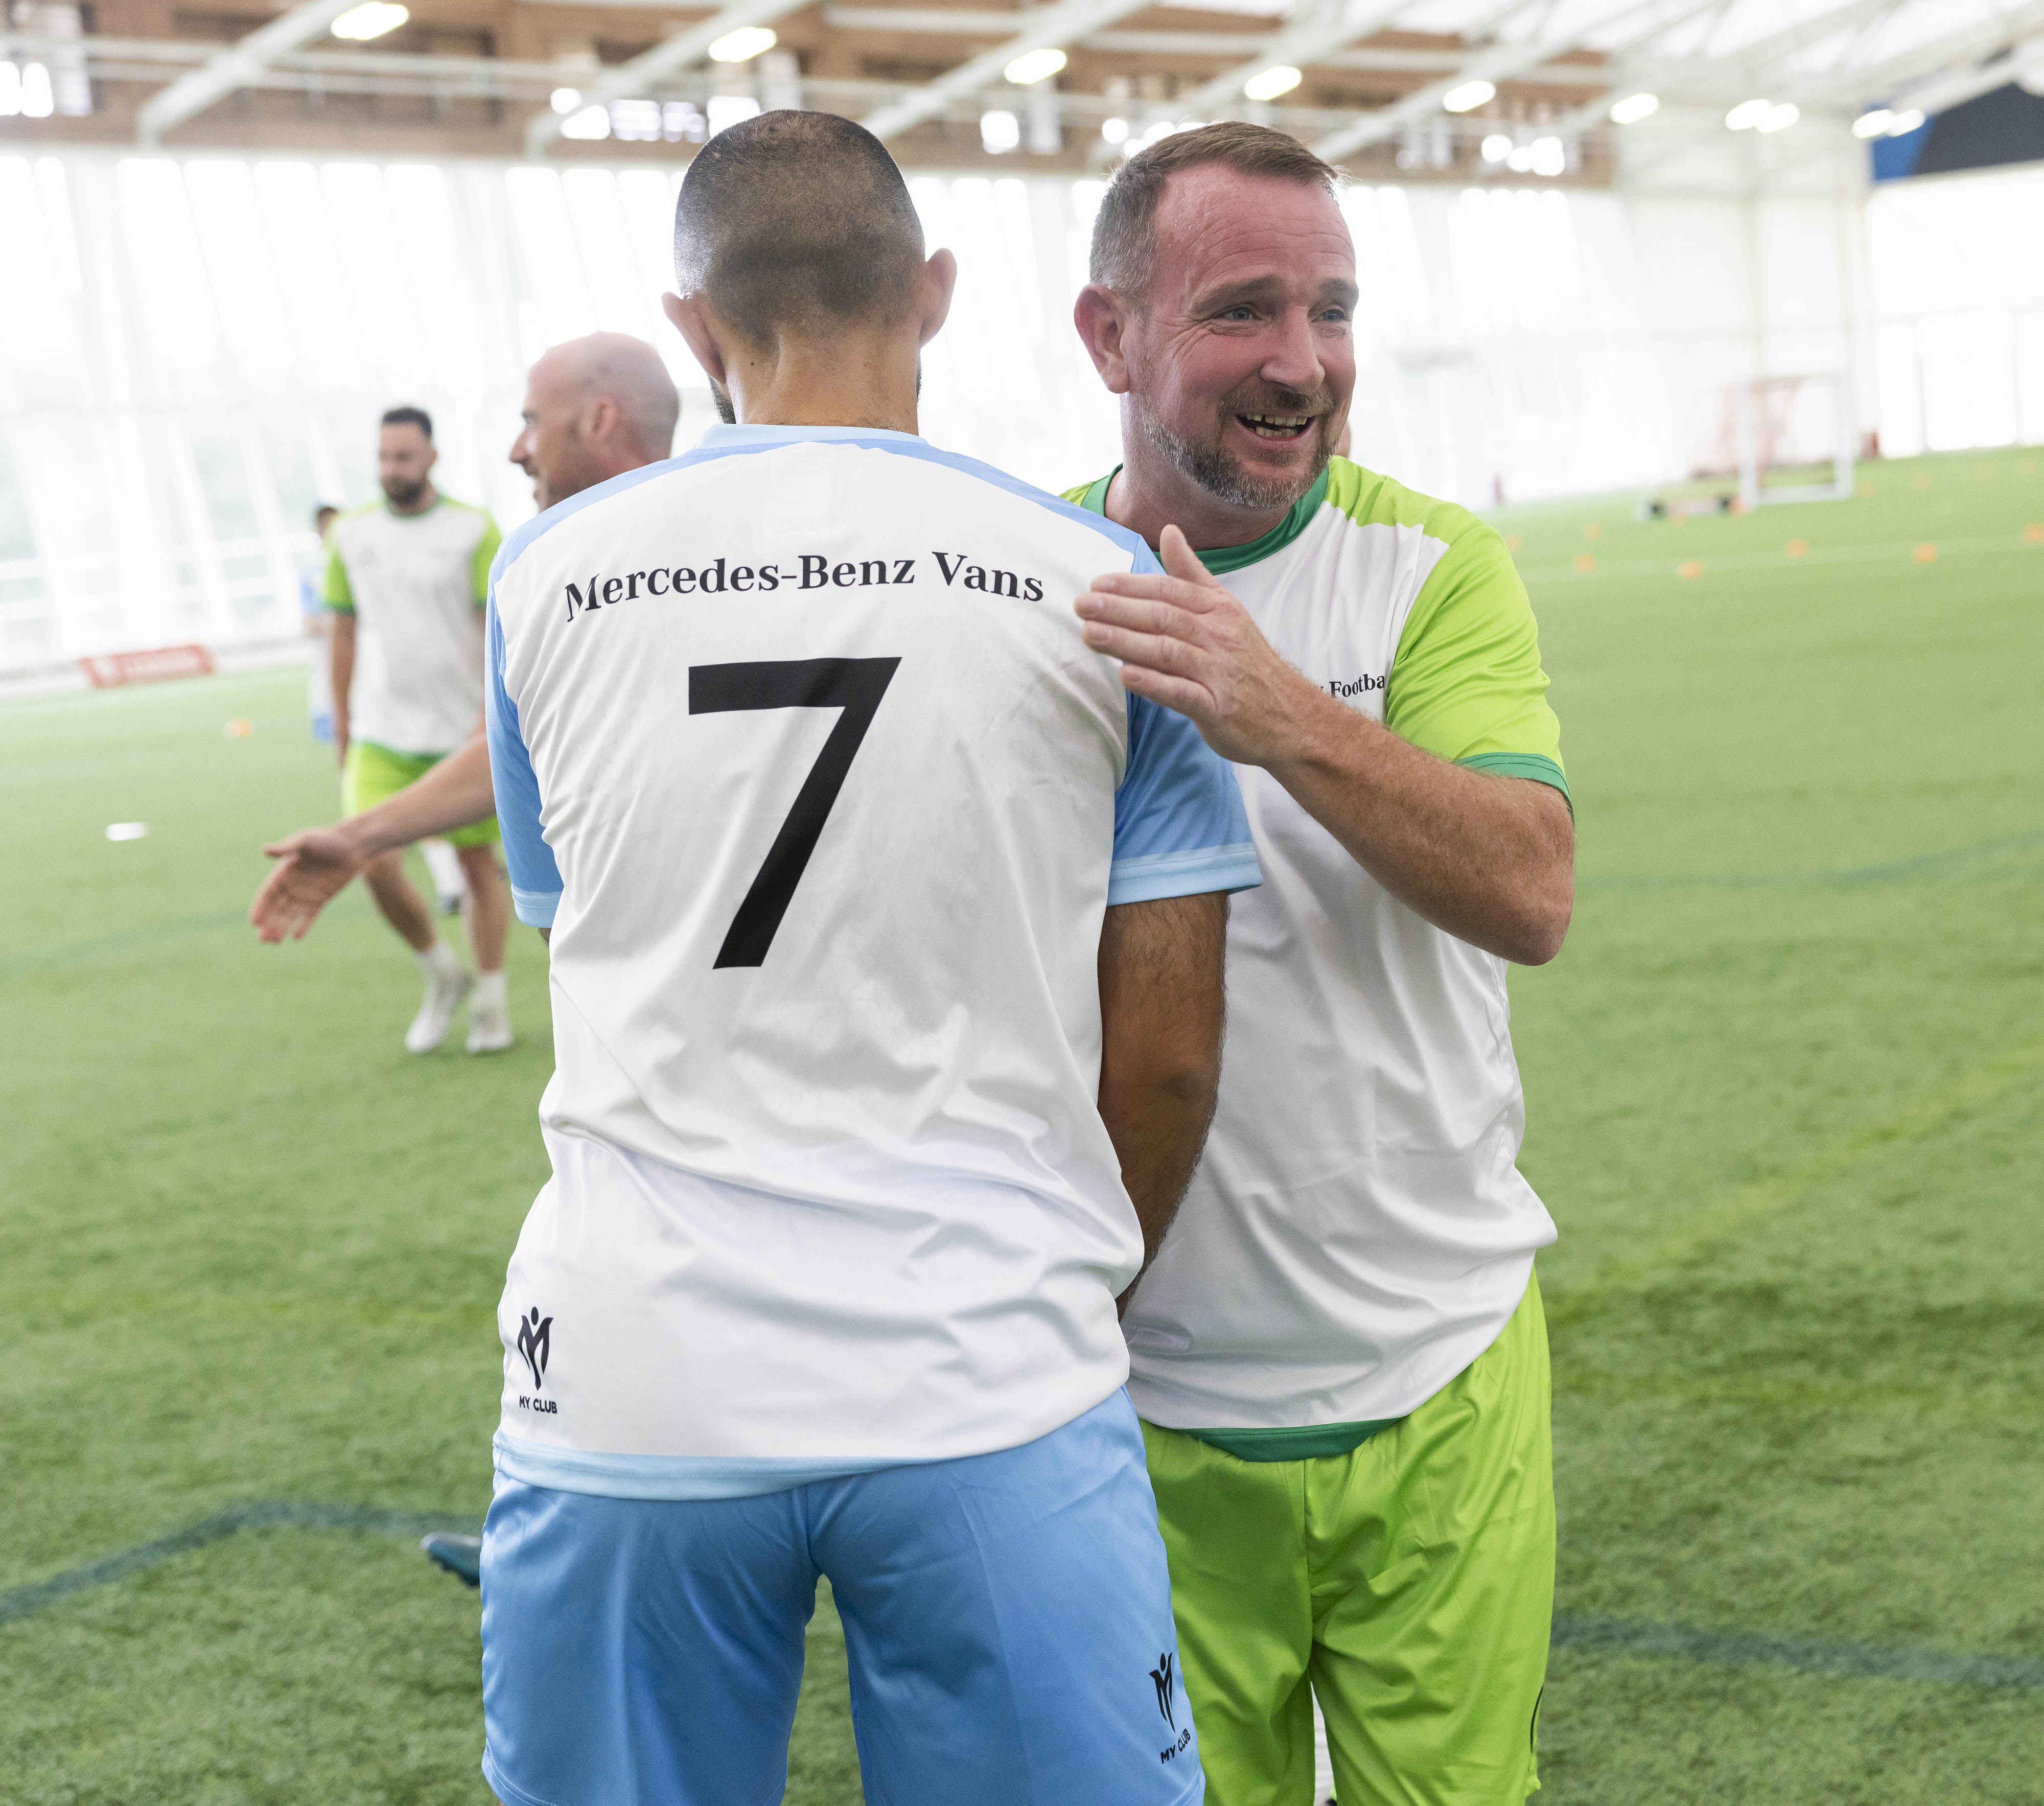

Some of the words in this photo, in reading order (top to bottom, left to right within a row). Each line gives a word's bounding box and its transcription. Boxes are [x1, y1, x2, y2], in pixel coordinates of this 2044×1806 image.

[565, 555, 915, 622] Mercedes-Benz
[932, 552, 1043, 601] Vans
[689, 657, 902, 969] 7
[519, 1395, 531, 1409] MY
[533, 1398, 558, 1414] CLUB
[1160, 1745, 1176, 1765] MY
[1178, 1728, 1191, 1752] CLUB
